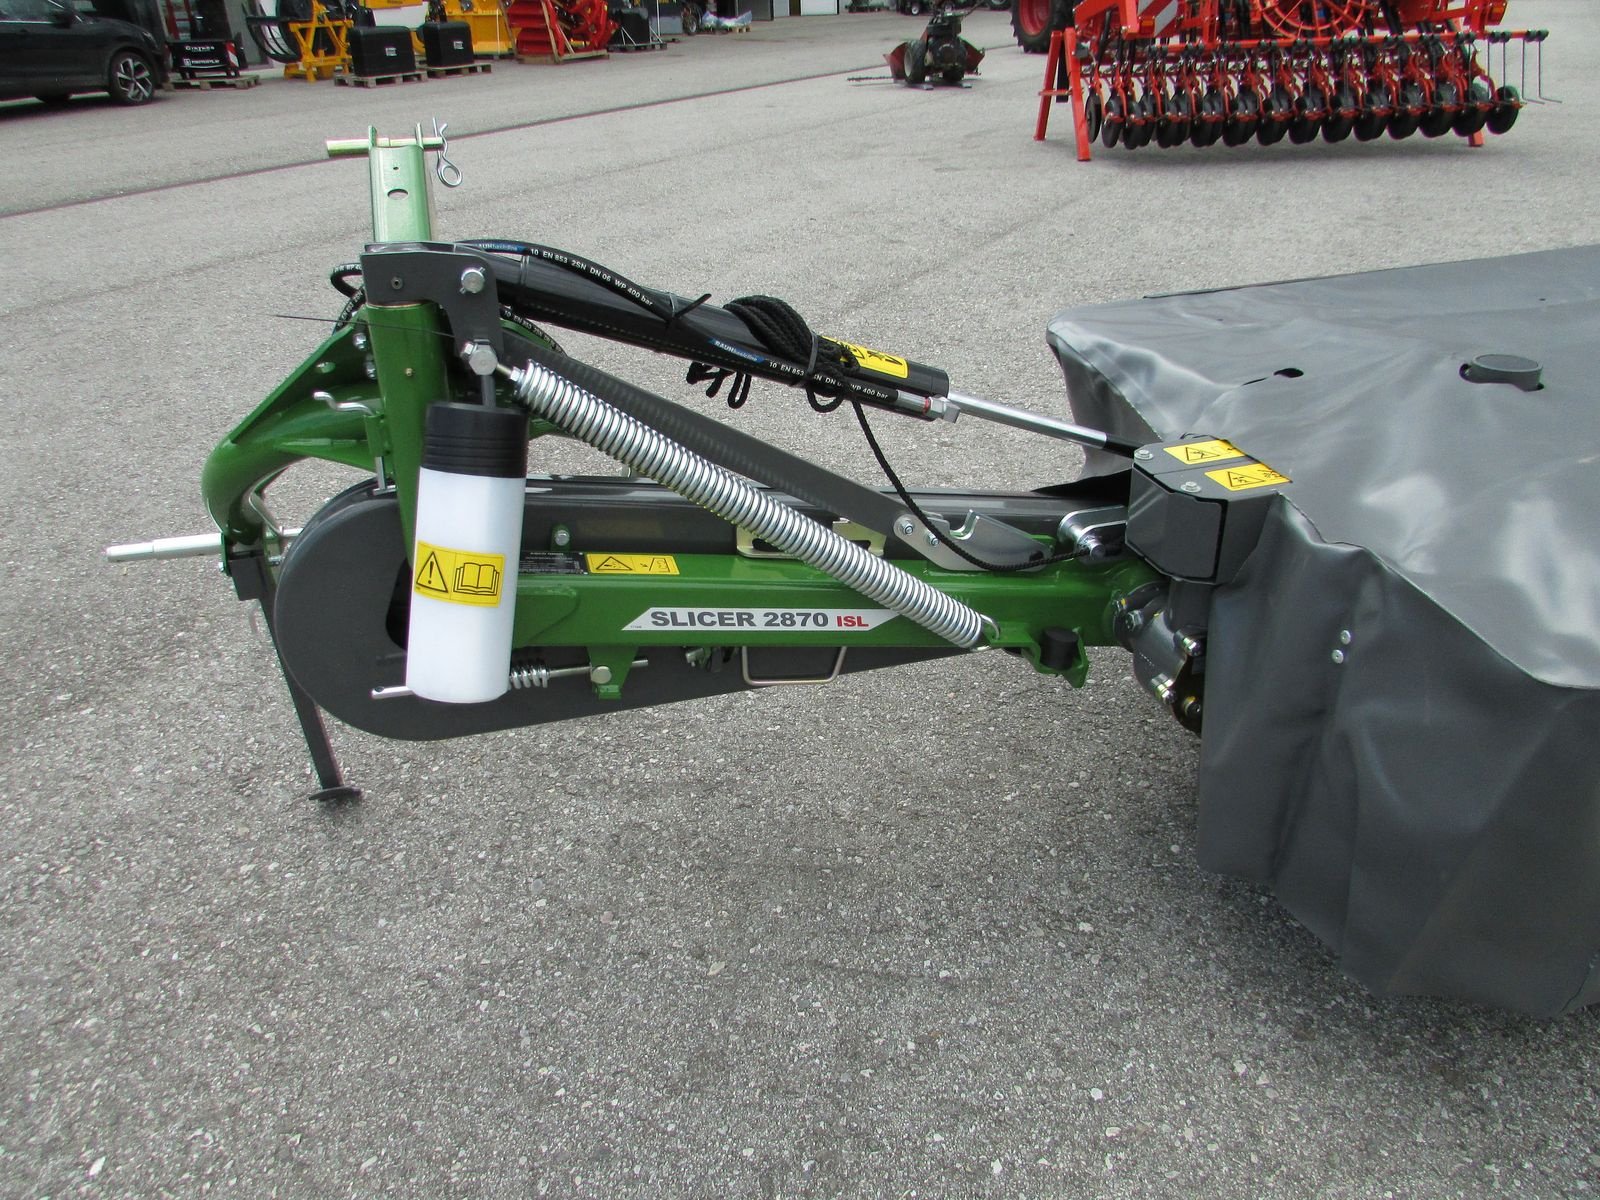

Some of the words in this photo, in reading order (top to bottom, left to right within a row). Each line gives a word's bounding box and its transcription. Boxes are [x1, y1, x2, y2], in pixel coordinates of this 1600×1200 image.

[530, 248, 539, 256] 10
[543, 250, 553, 259] EN
[554, 254, 568, 264] 853
[571, 260, 587, 271] 2SN
[590, 267, 601, 277] DN
[602, 273, 612, 282] 06
[614, 279, 627, 289] WP
[627, 287, 641, 298] 400
[640, 295, 653, 306] bar
[769, 361, 778, 369] 10
[780, 364, 791, 373] EN
[791, 368, 805, 377] 853
[825, 377, 836, 385] DN
[862, 387, 876, 395] 400
[876, 391, 889, 399] bar
[651, 611, 757, 627] SLICER
[763, 611, 829, 627] 2870
[836, 615, 869, 627] ISL
